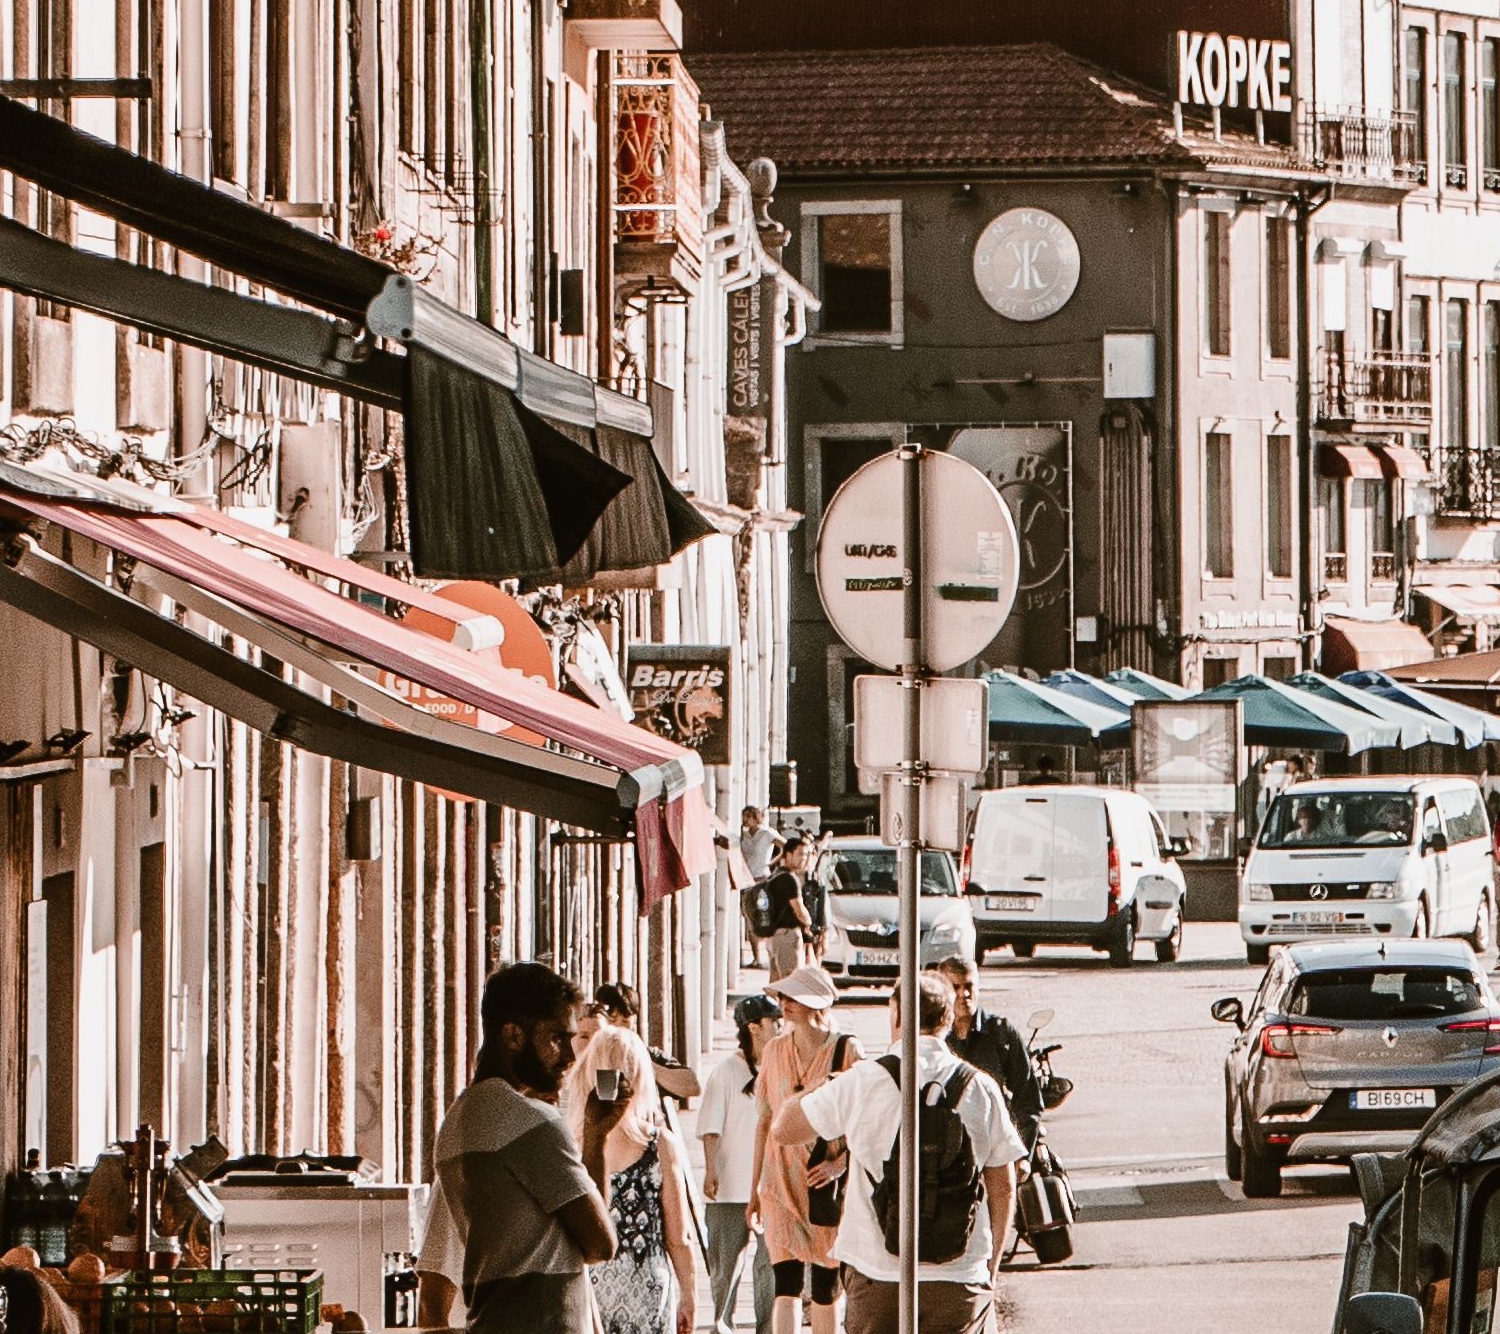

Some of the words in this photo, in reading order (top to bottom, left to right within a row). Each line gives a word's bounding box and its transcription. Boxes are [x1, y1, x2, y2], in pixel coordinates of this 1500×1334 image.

[1177, 30, 1292, 113] KOPKE
[733, 347, 749, 407] CAVES
[631, 664, 725, 687] Barris
